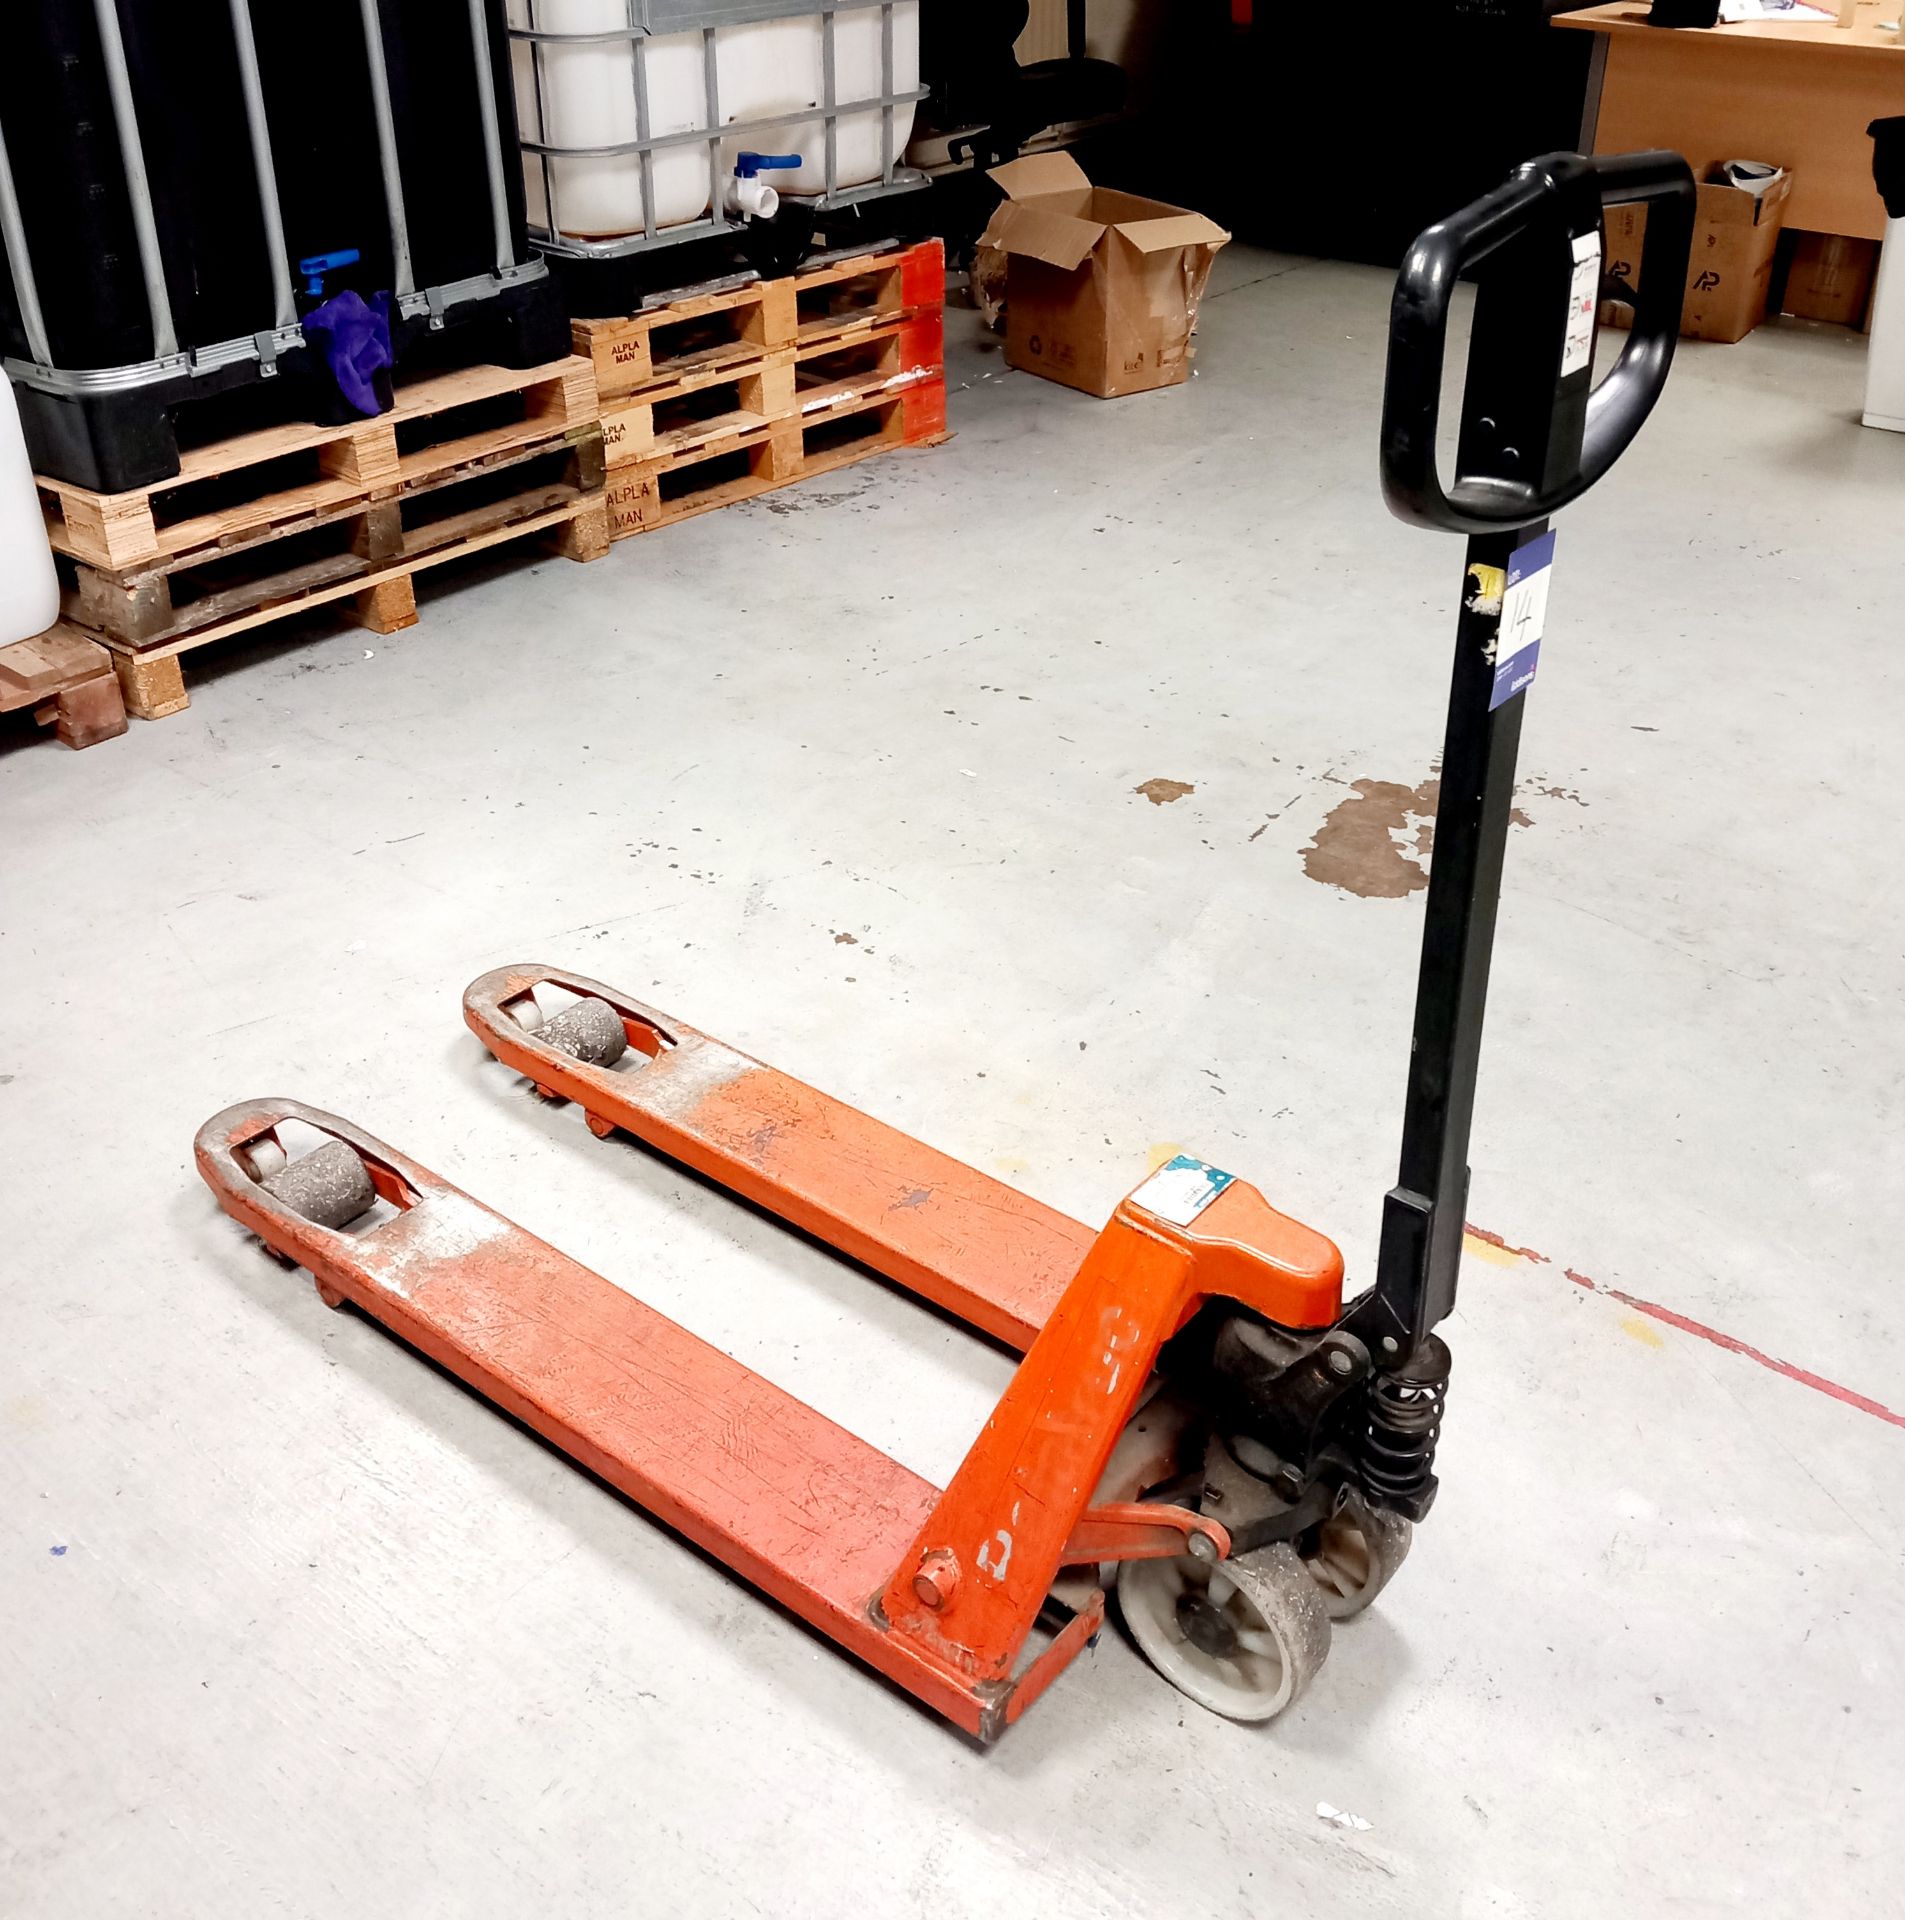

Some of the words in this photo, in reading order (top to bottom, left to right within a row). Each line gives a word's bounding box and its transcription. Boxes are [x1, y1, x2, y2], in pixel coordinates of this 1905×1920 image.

[611, 341, 640, 355] ALPLA
[615, 351, 635, 364] MAN
[603, 423, 626, 436] LPLA
[606, 482, 650, 508] ALPLA
[615, 509, 644, 528] MAN
[1510, 588, 1532, 641] 14
